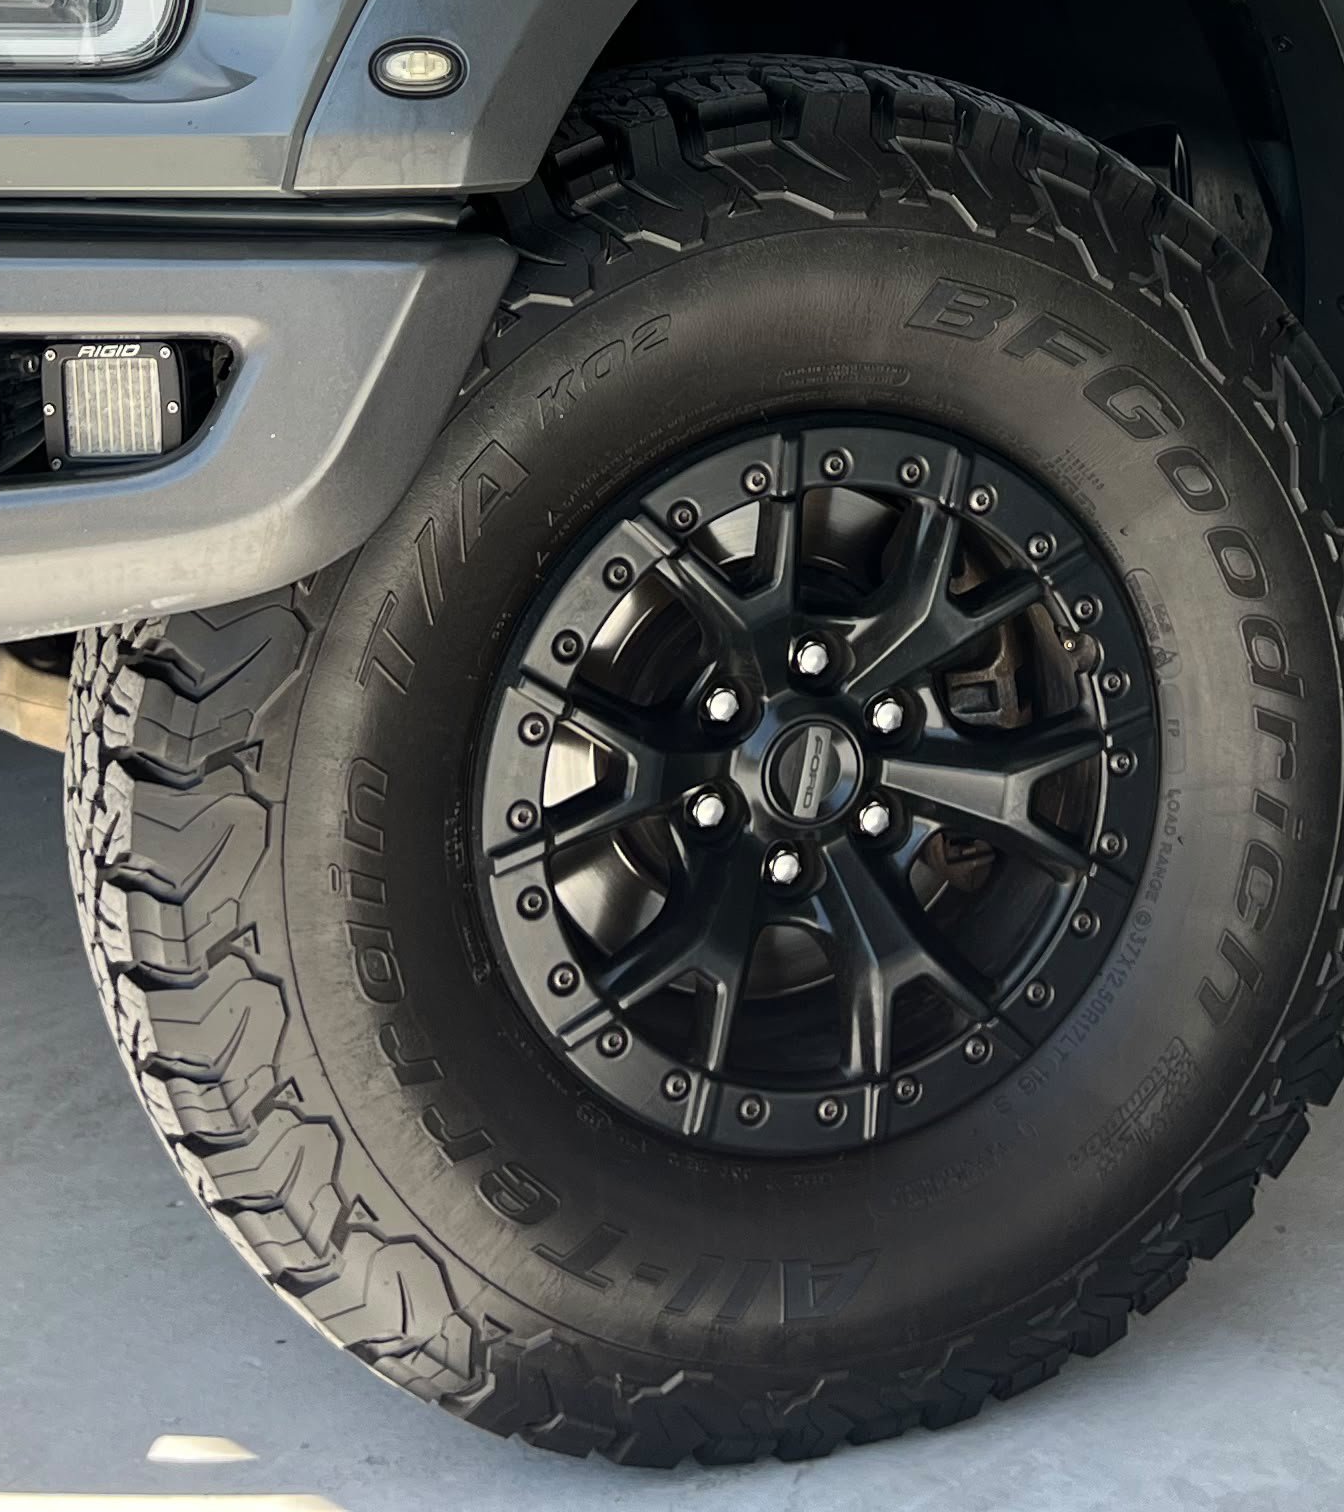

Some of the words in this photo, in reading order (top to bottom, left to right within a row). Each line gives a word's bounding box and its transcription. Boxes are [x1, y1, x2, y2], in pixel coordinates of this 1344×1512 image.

[77, 343, 141, 358] RIGID
[533, 312, 673, 430] KO2
[354, 438, 531, 695] T/A
[904, 276, 1306, 1026] BFGoodrich
[802, 735, 824, 809] FORD
[1163, 788, 1183, 838] LOAD
[1144, 841, 1174, 903] RANGE
[328, 756, 882, 1328] All-Terrain
